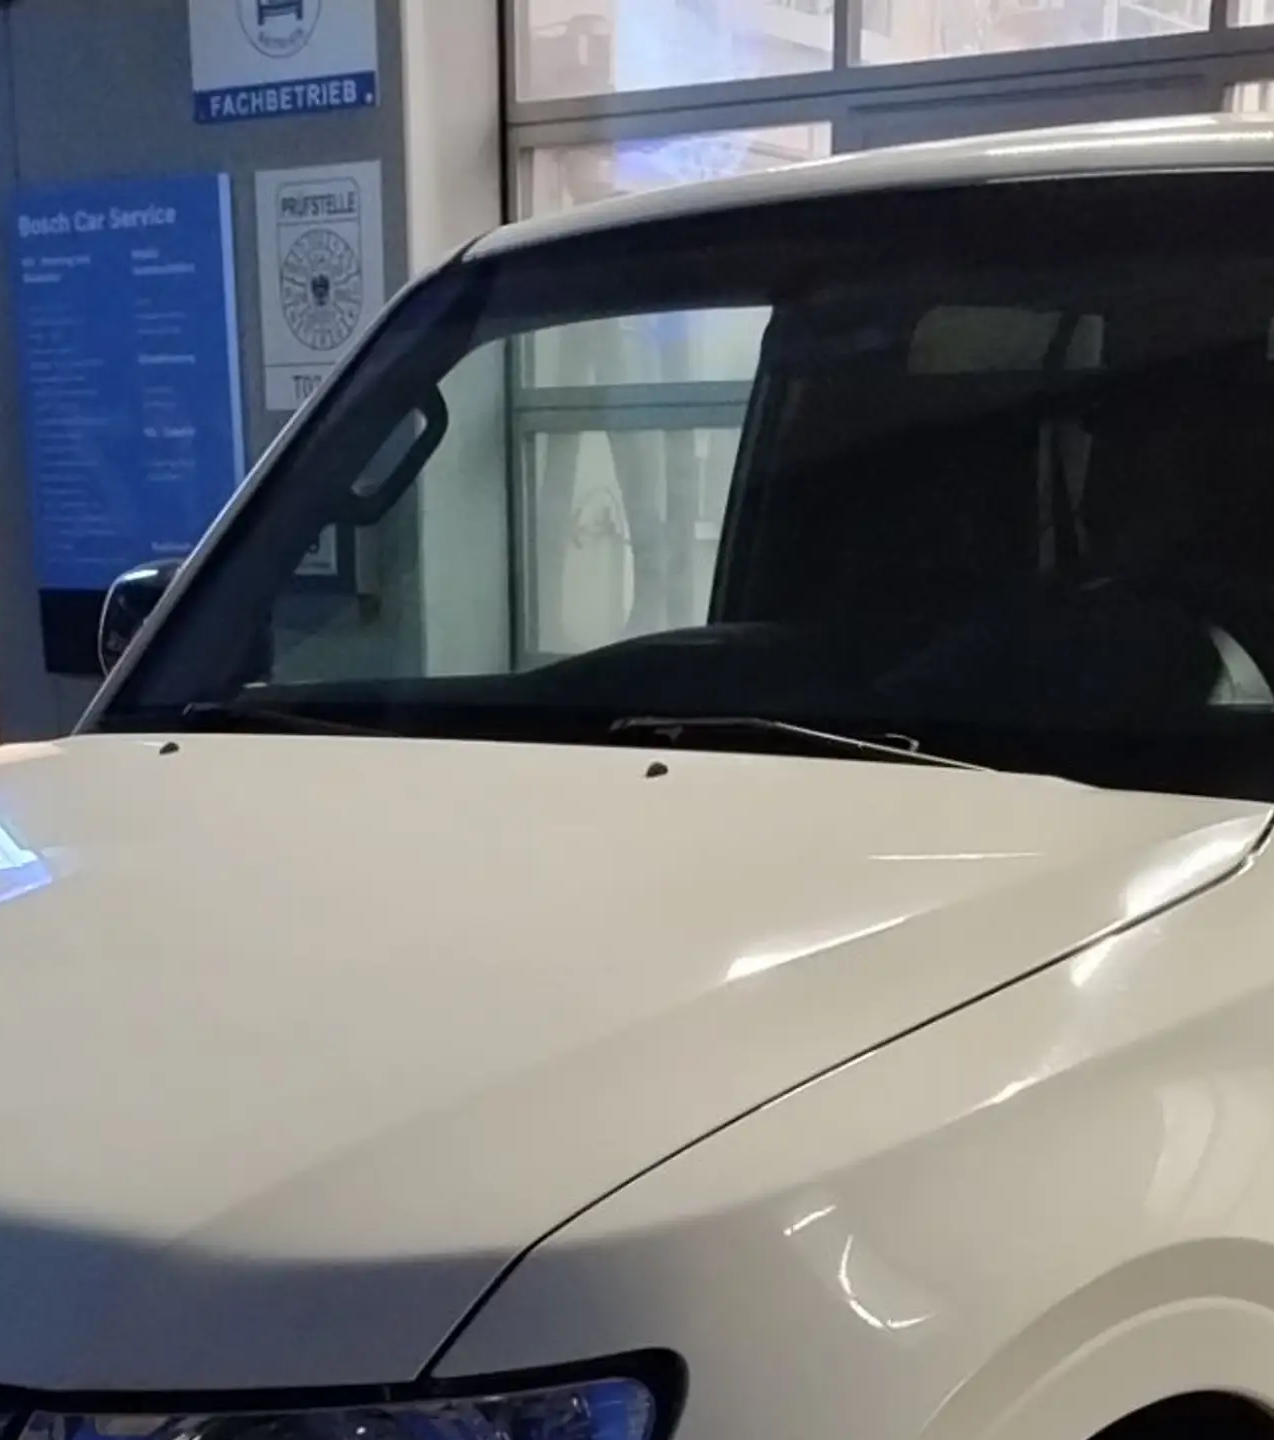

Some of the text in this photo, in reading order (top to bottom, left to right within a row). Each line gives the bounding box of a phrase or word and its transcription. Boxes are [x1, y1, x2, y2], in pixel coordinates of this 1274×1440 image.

[210, 79, 357, 118] FACHBETRIEB
[18, 203, 177, 239] Bosch Car Service
[281, 190, 356, 217] PRÜFSTELLE
